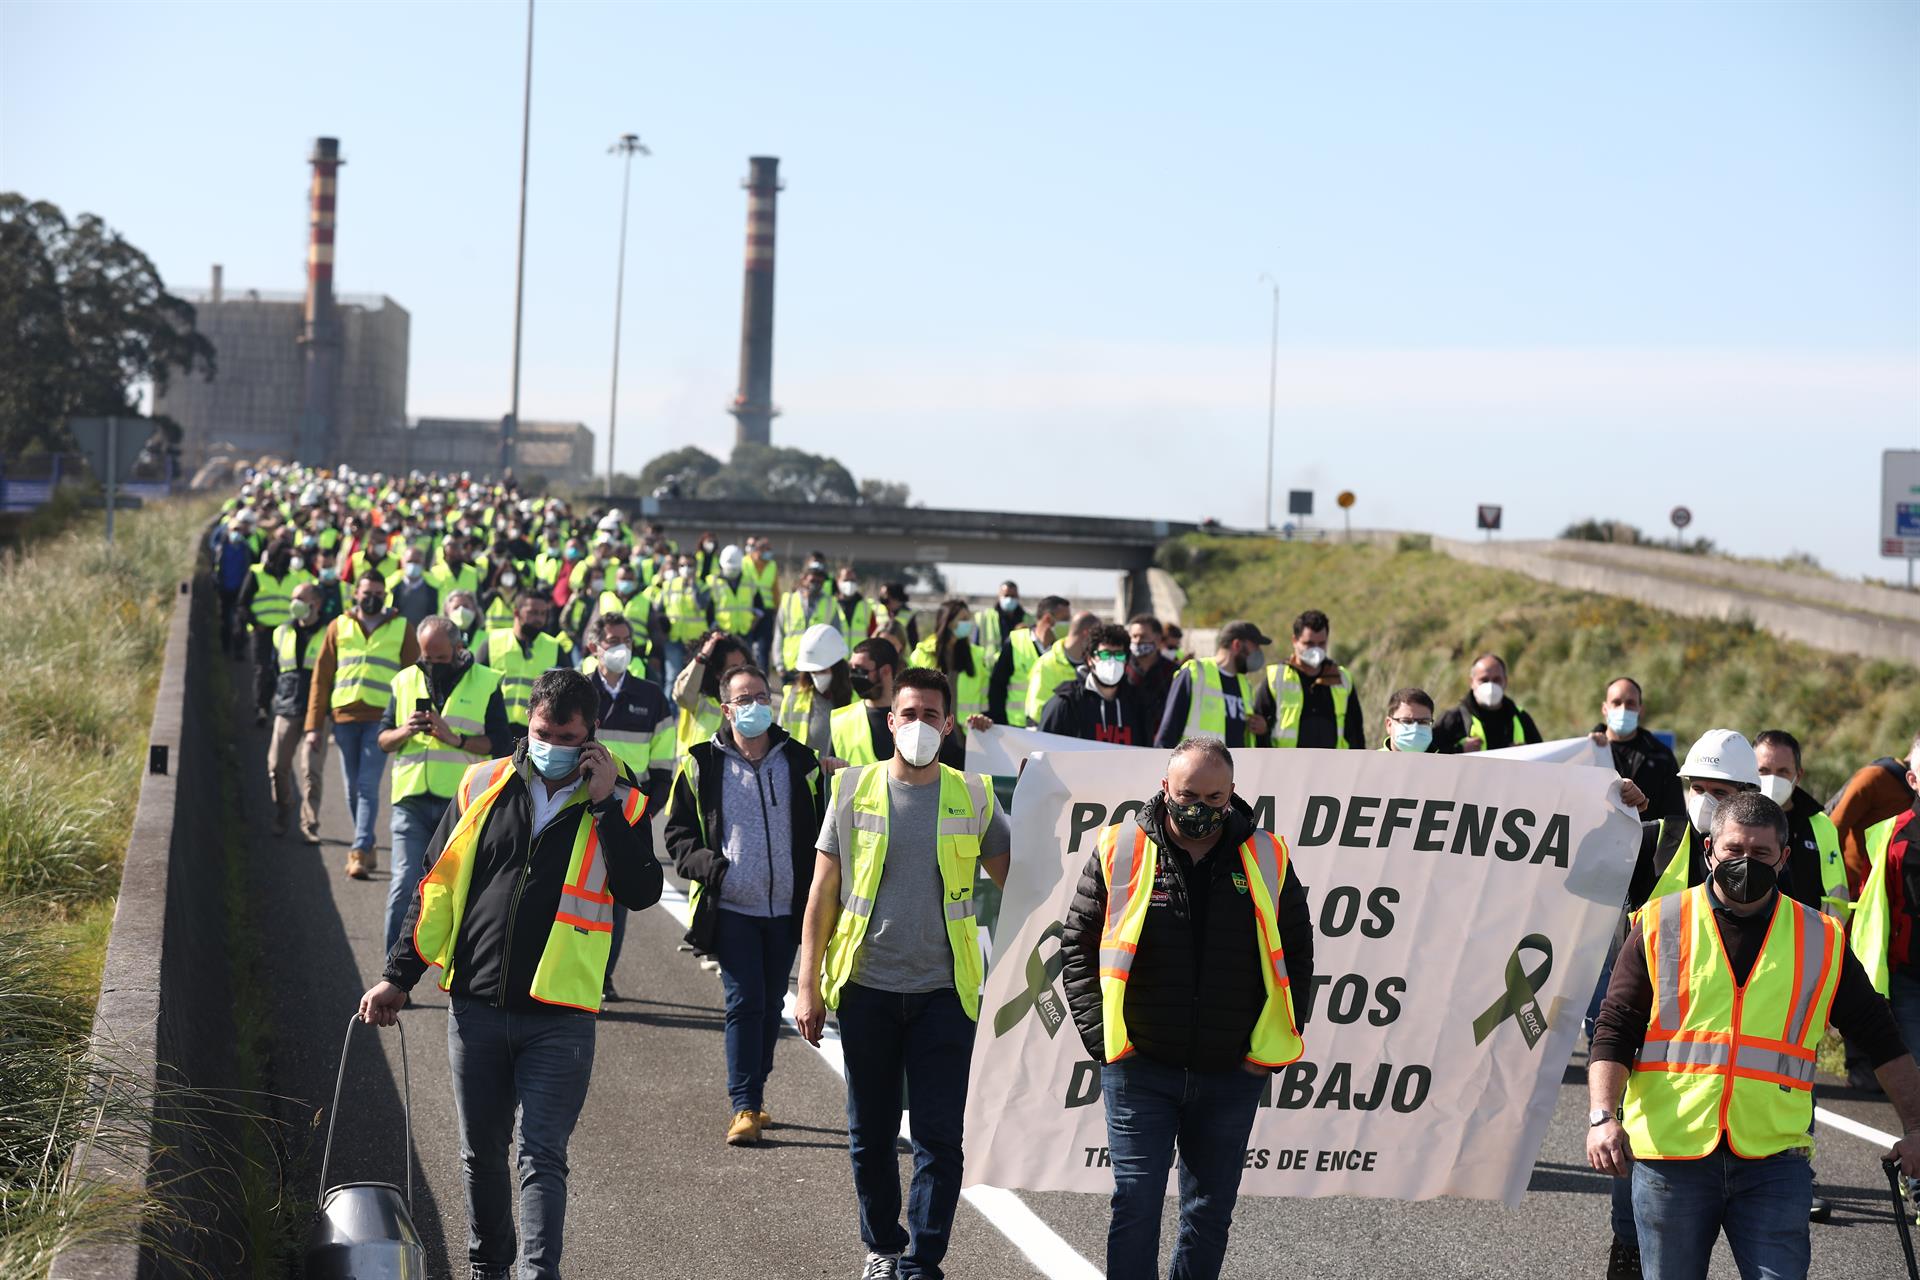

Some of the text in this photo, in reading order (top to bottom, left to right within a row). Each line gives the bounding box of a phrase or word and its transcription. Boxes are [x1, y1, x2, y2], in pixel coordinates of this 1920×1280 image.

[1298, 795, 1570, 868] DEFENSA
[1302, 885, 1401, 938] OS
[1043, 1001, 1062, 1025] ence
[1524, 1012, 1541, 1036] ence
[1277, 1149, 1309, 1170] DE
[1315, 1149, 1377, 1171] ENCE
